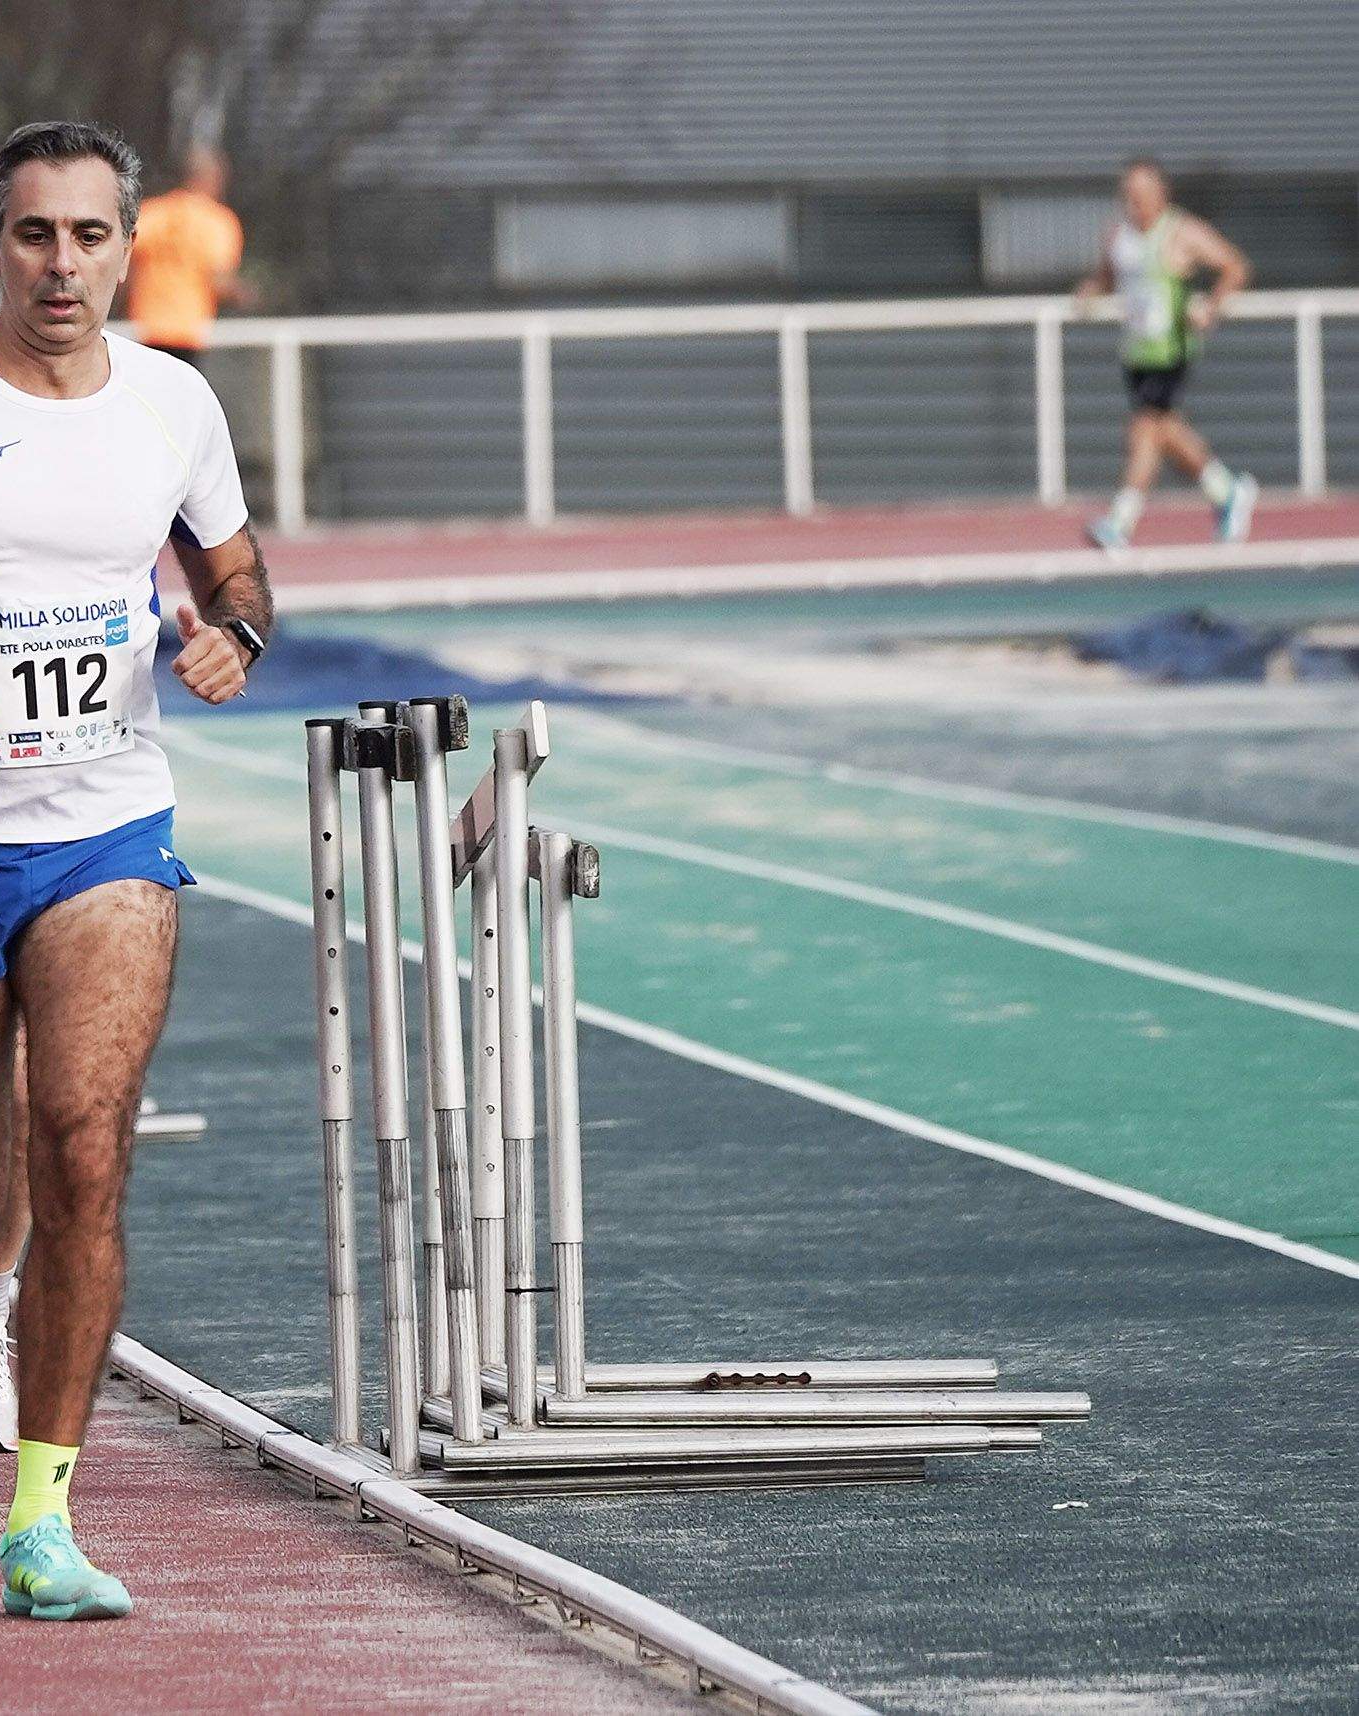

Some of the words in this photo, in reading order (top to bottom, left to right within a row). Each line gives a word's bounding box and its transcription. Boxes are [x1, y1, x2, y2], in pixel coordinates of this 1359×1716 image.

[52, 598, 128, 626] SOLIDARIA
[23, 640, 53, 654] POLA
[56, 634, 105, 650] DIABETES
[12, 653, 108, 720] 112
